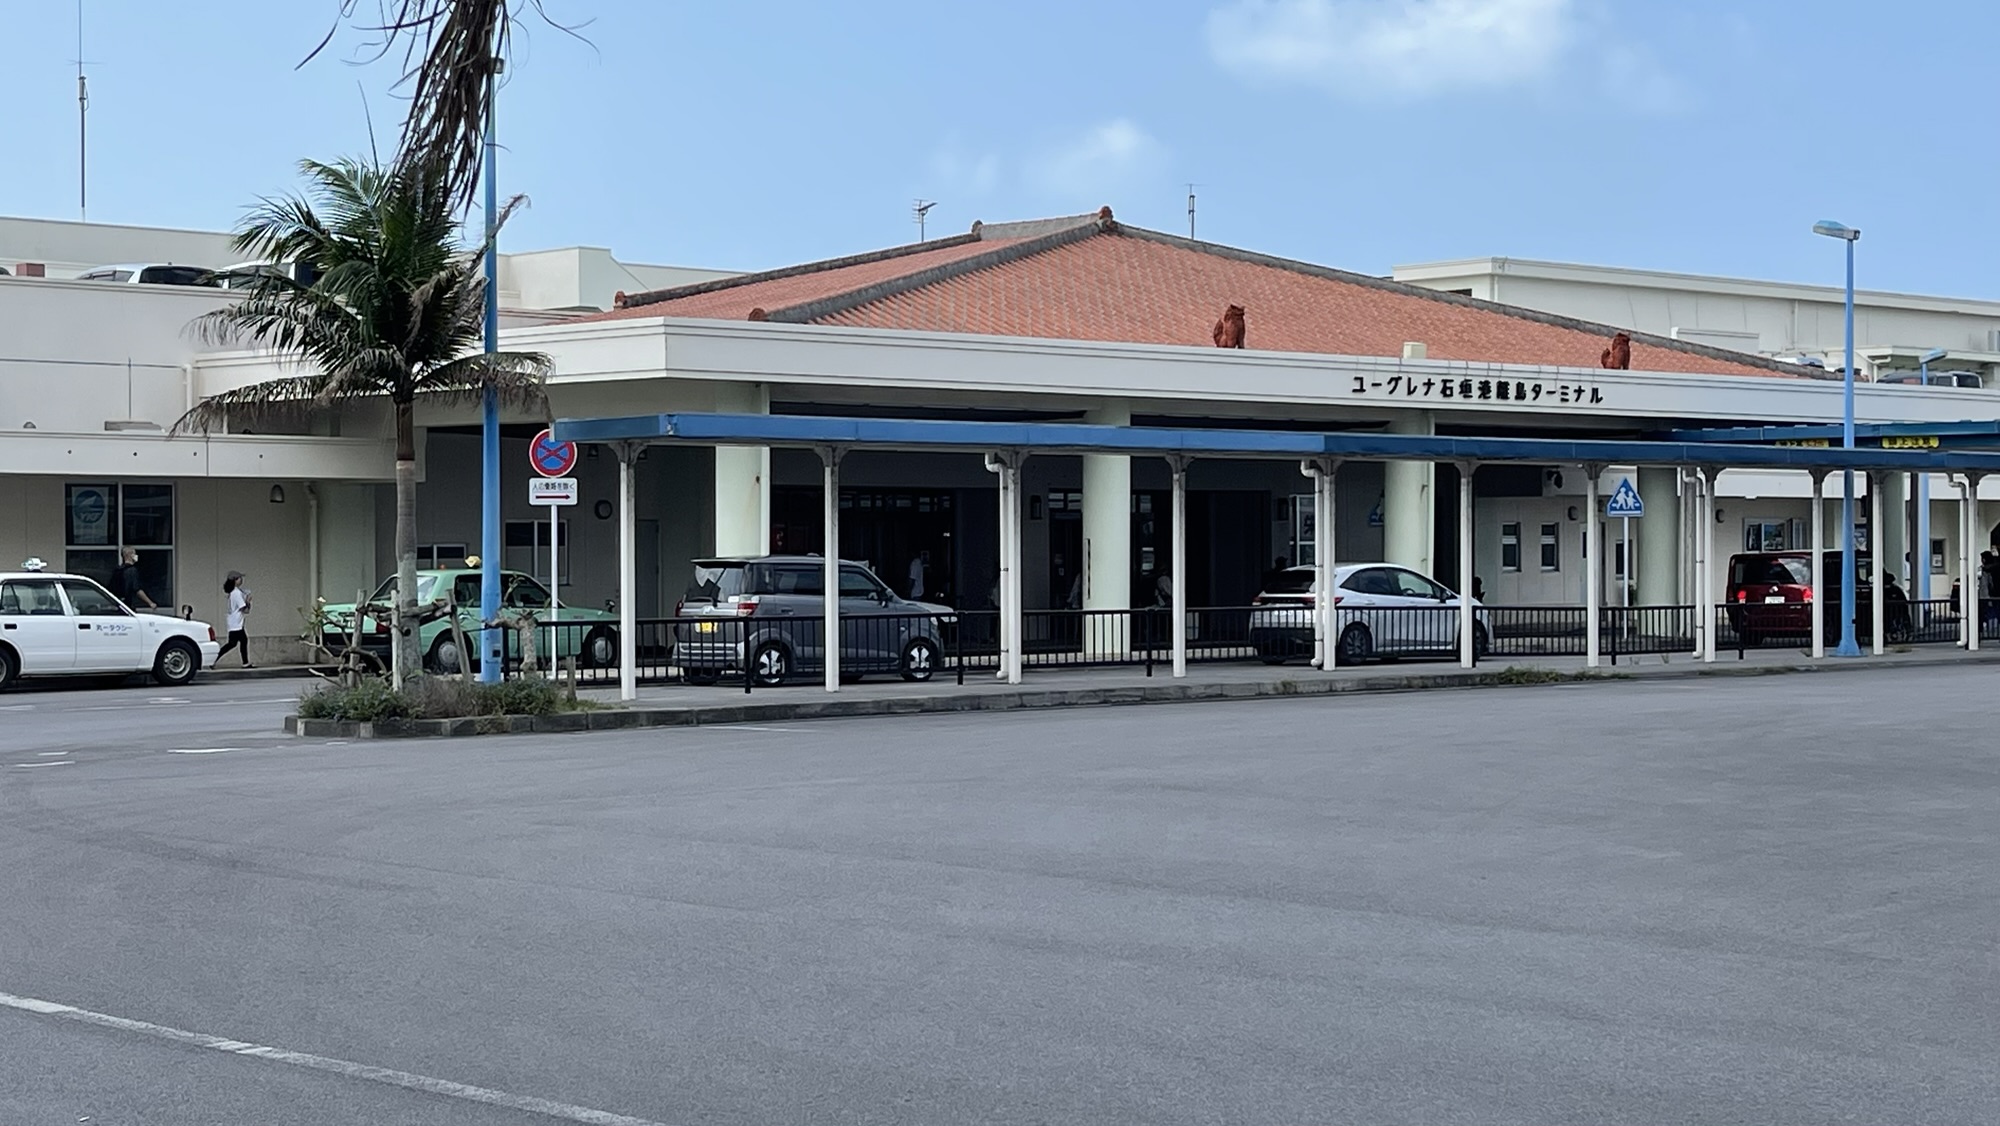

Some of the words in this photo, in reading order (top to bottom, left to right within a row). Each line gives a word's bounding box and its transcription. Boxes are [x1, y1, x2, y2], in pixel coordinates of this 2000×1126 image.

[1352, 376, 1603, 404] ユーグレナ石垣港離島ターミナル
